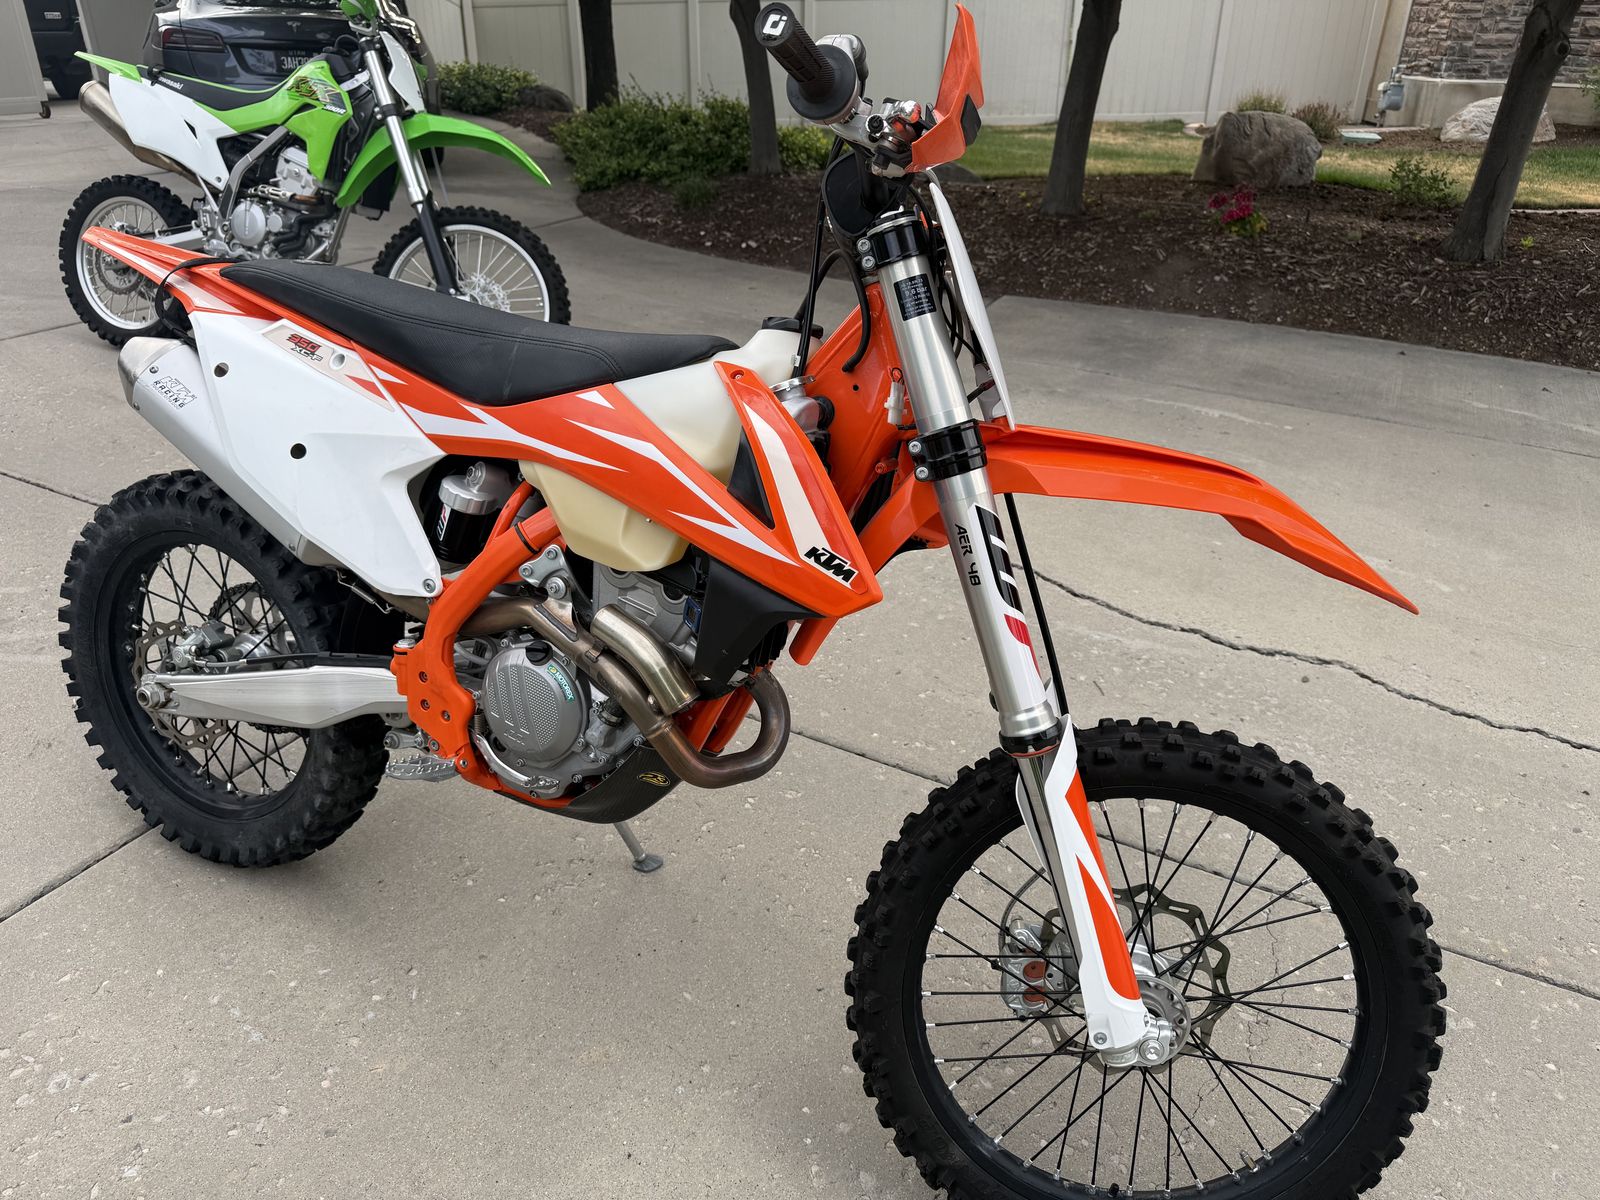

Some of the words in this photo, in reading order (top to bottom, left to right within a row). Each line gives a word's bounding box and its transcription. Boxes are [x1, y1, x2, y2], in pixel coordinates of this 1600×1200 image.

[286, 333, 322, 353] 350
[153, 380, 186, 408] RACING
[803, 545, 857, 583] KTM
[954, 523, 973, 557] AER
[967, 561, 982, 586] 48
[554, 671, 575, 701] MOTOREX
